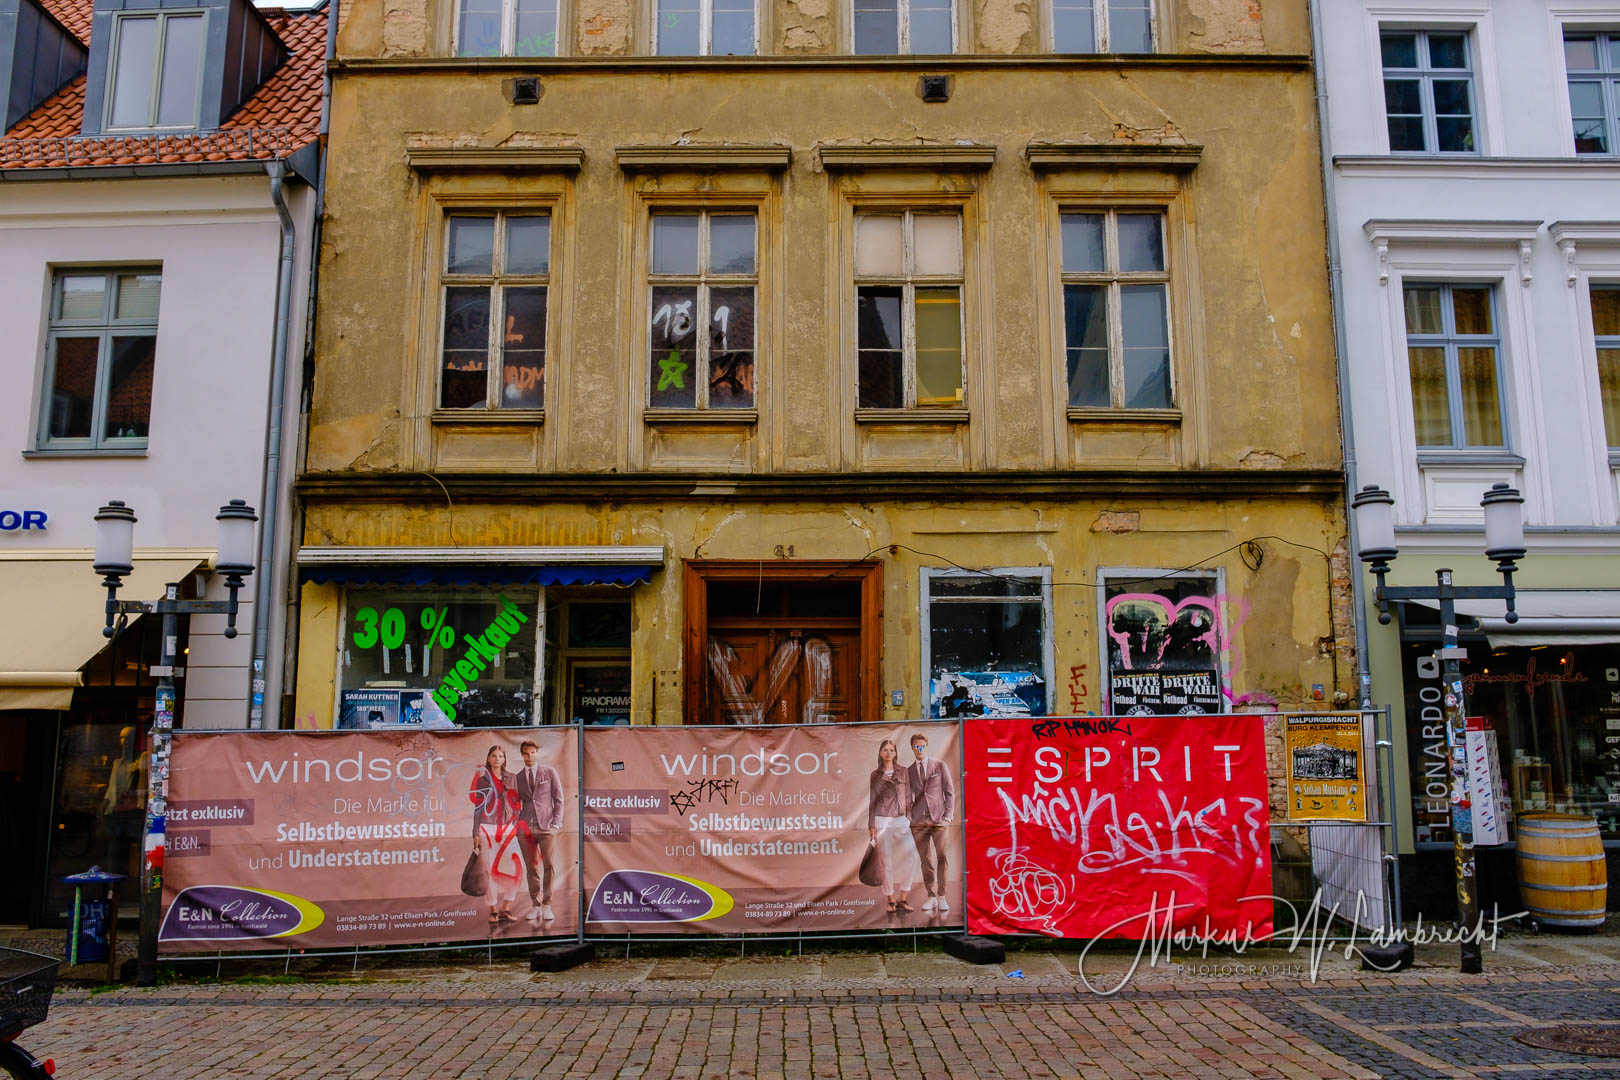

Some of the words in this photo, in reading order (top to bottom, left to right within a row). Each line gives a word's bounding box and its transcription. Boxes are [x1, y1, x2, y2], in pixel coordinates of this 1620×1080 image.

[0, 510, 48, 530] OR
[773, 544, 795, 557] 61
[353, 606, 406, 650] 30
[420, 606, 455, 649] %
[1113, 676, 1160, 688] DRITTE
[1163, 676, 1210, 688] DRITTE
[581, 696, 631, 706] PANORAMA
[1288, 716, 1358, 724] WALPURGISNACHT
[661, 747, 842, 776] windsor.
[987, 745, 1240, 782] ESPRIT
[1419, 687, 1450, 828] LEONARDO
[334, 796, 361, 813] Die
[367, 795, 418, 812] Marke
[583, 795, 611, 808] Jetzt
[614, 795, 661, 809] exklusiv
[740, 790, 765, 806] Die
[769, 789, 816, 805] Marke
[821, 788, 842, 804] für
[164, 805, 188, 821] etzt
[191, 805, 245, 820] exklusiv
[689, 811, 843, 831] Selbstbewusstsein
[276, 818, 446, 842] Selbstbewusstsein
[583, 823, 598, 835] bei
[600, 822, 623, 836] E&N.
[163, 838, 172, 851] ei
[174, 836, 201, 851] E&N.
[665, 841, 696, 857] und
[700, 838, 844, 857] Understatement.
[249, 852, 283, 869] und
[288, 846, 446, 869] Understatement.
[603, 891, 633, 905] E&N
[640, 884, 701, 906] Collection
[179, 906, 213, 921] E&N
[220, 899, 289, 922] Collection
[336, 915, 357, 924] Lange
[358, 914, 379, 922] Straße
[404, 912, 423, 920] Elisen
[443, 909, 477, 918] Greifswald
[798, 908, 855, 916] www.e-n-online.de
[336, 923, 368, 932] 03834-89
[394, 919, 455, 929] www.e-n-online.de
